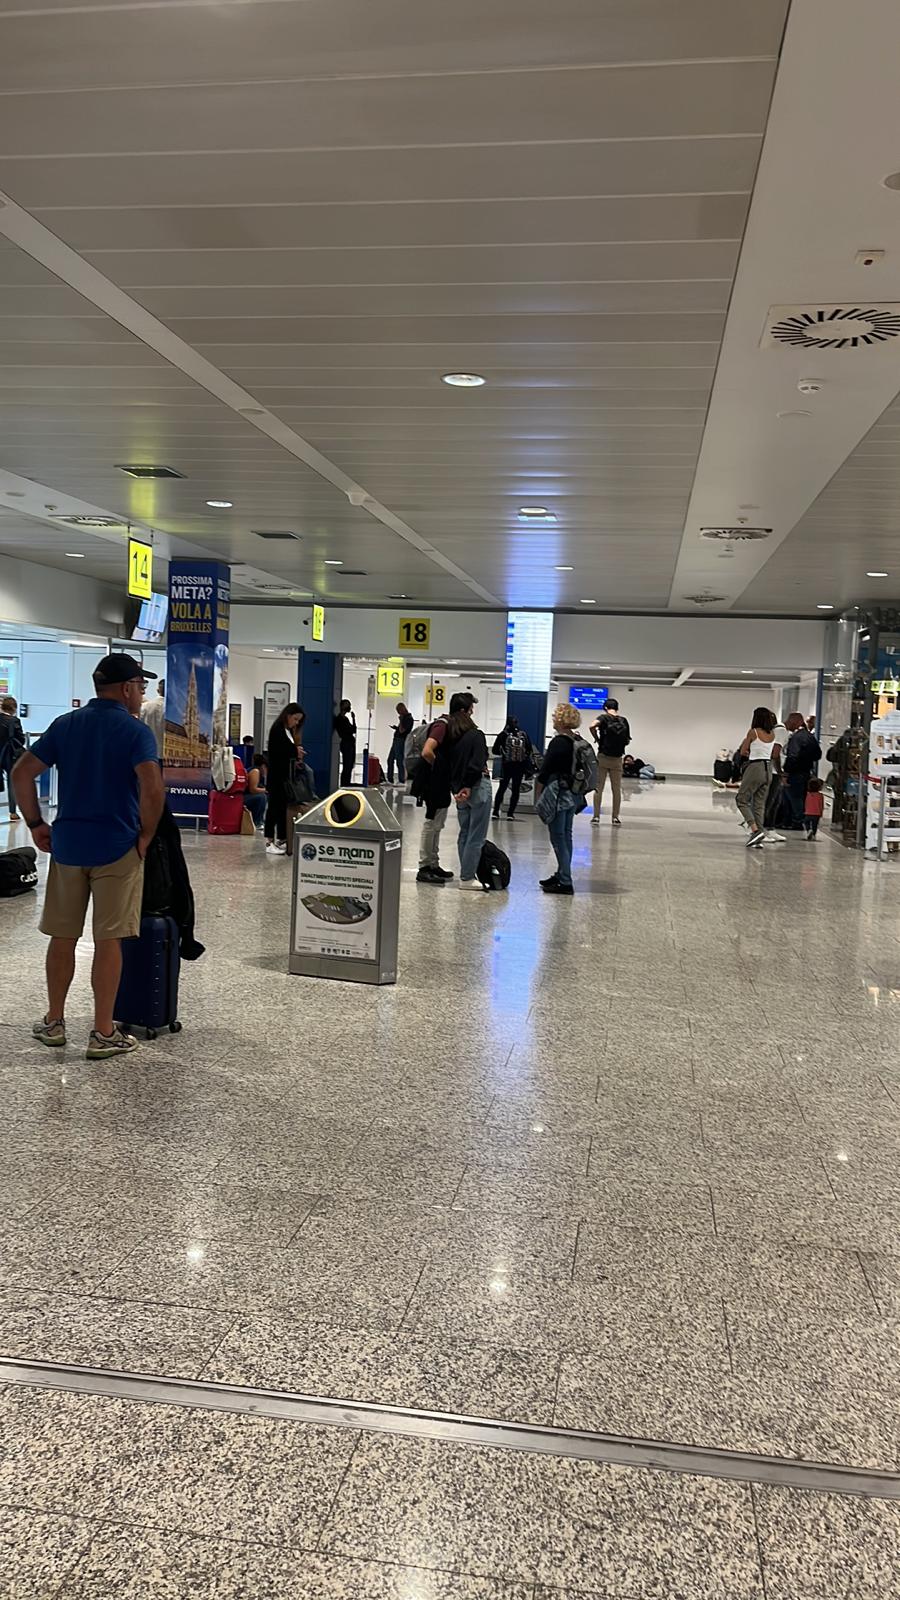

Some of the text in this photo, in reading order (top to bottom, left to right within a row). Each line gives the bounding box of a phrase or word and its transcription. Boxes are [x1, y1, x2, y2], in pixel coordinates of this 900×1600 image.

[133, 551, 148, 585] 14
[171, 575, 213, 586] PROSSIMA
[171, 586, 213, 600] META?
[171, 602, 201, 619] VOLA
[203, 603, 212, 619] A
[170, 621, 212, 633] BRUXELLES
[402, 623, 427, 642] 18
[381, 672, 400, 687] 18
[170, 787, 208, 796] RYANAIR
